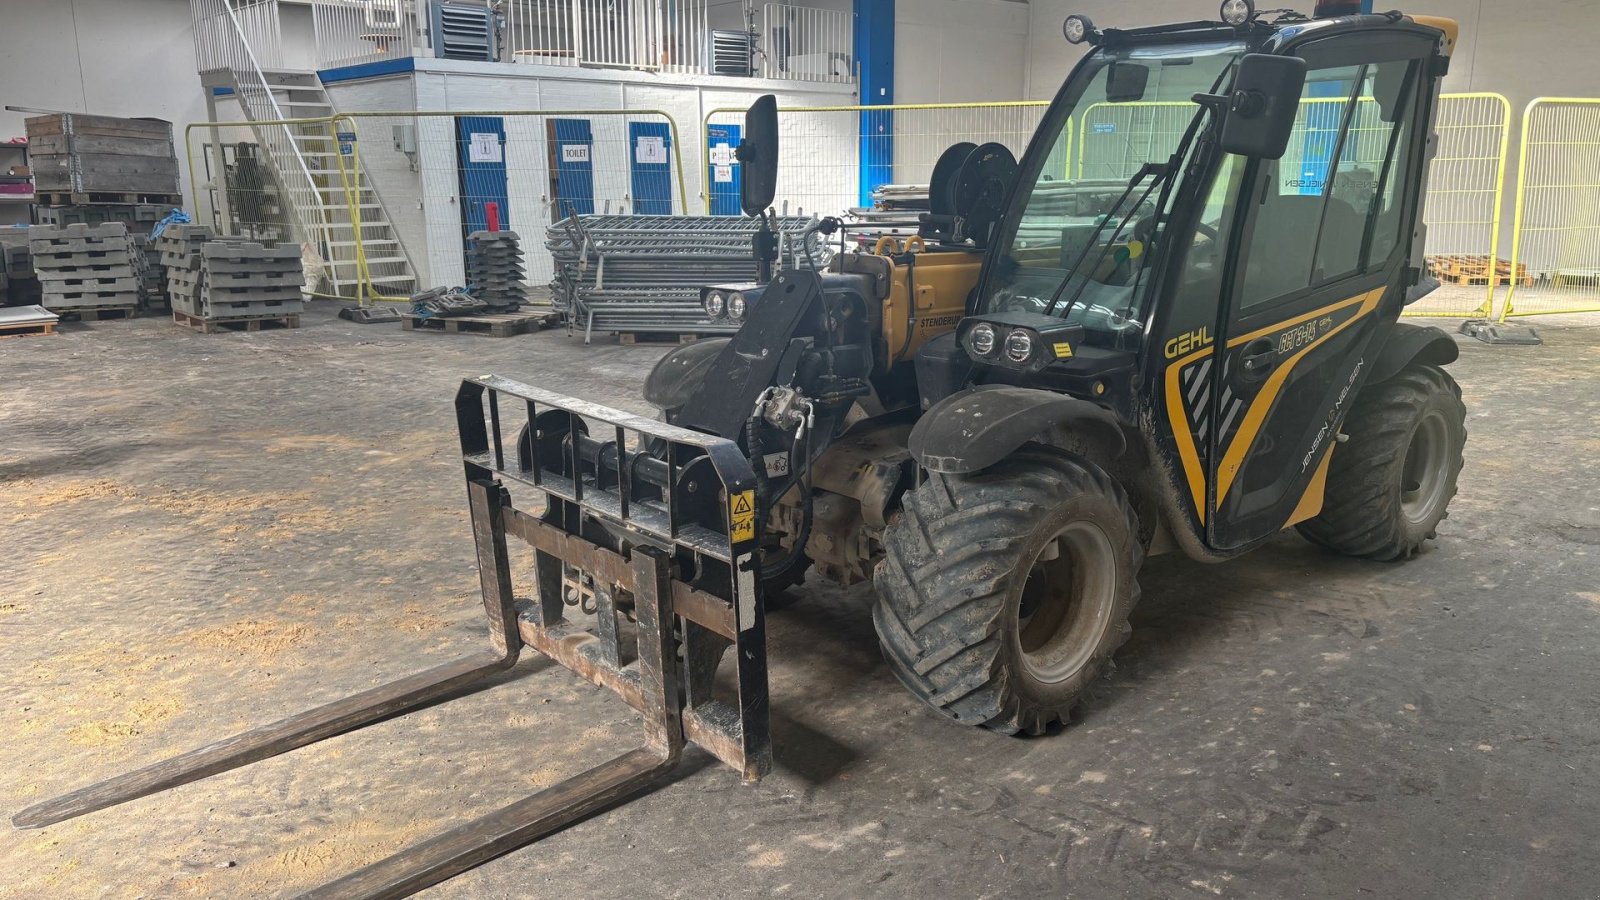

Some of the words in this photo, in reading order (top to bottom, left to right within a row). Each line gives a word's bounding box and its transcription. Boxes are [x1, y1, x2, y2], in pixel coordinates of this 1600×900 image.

[565, 149, 586, 158] TOILET
[1164, 326, 1213, 358] GEHL
[1301, 421, 1329, 474] JENSEN
[1335, 357, 1364, 410] NIELSEN
